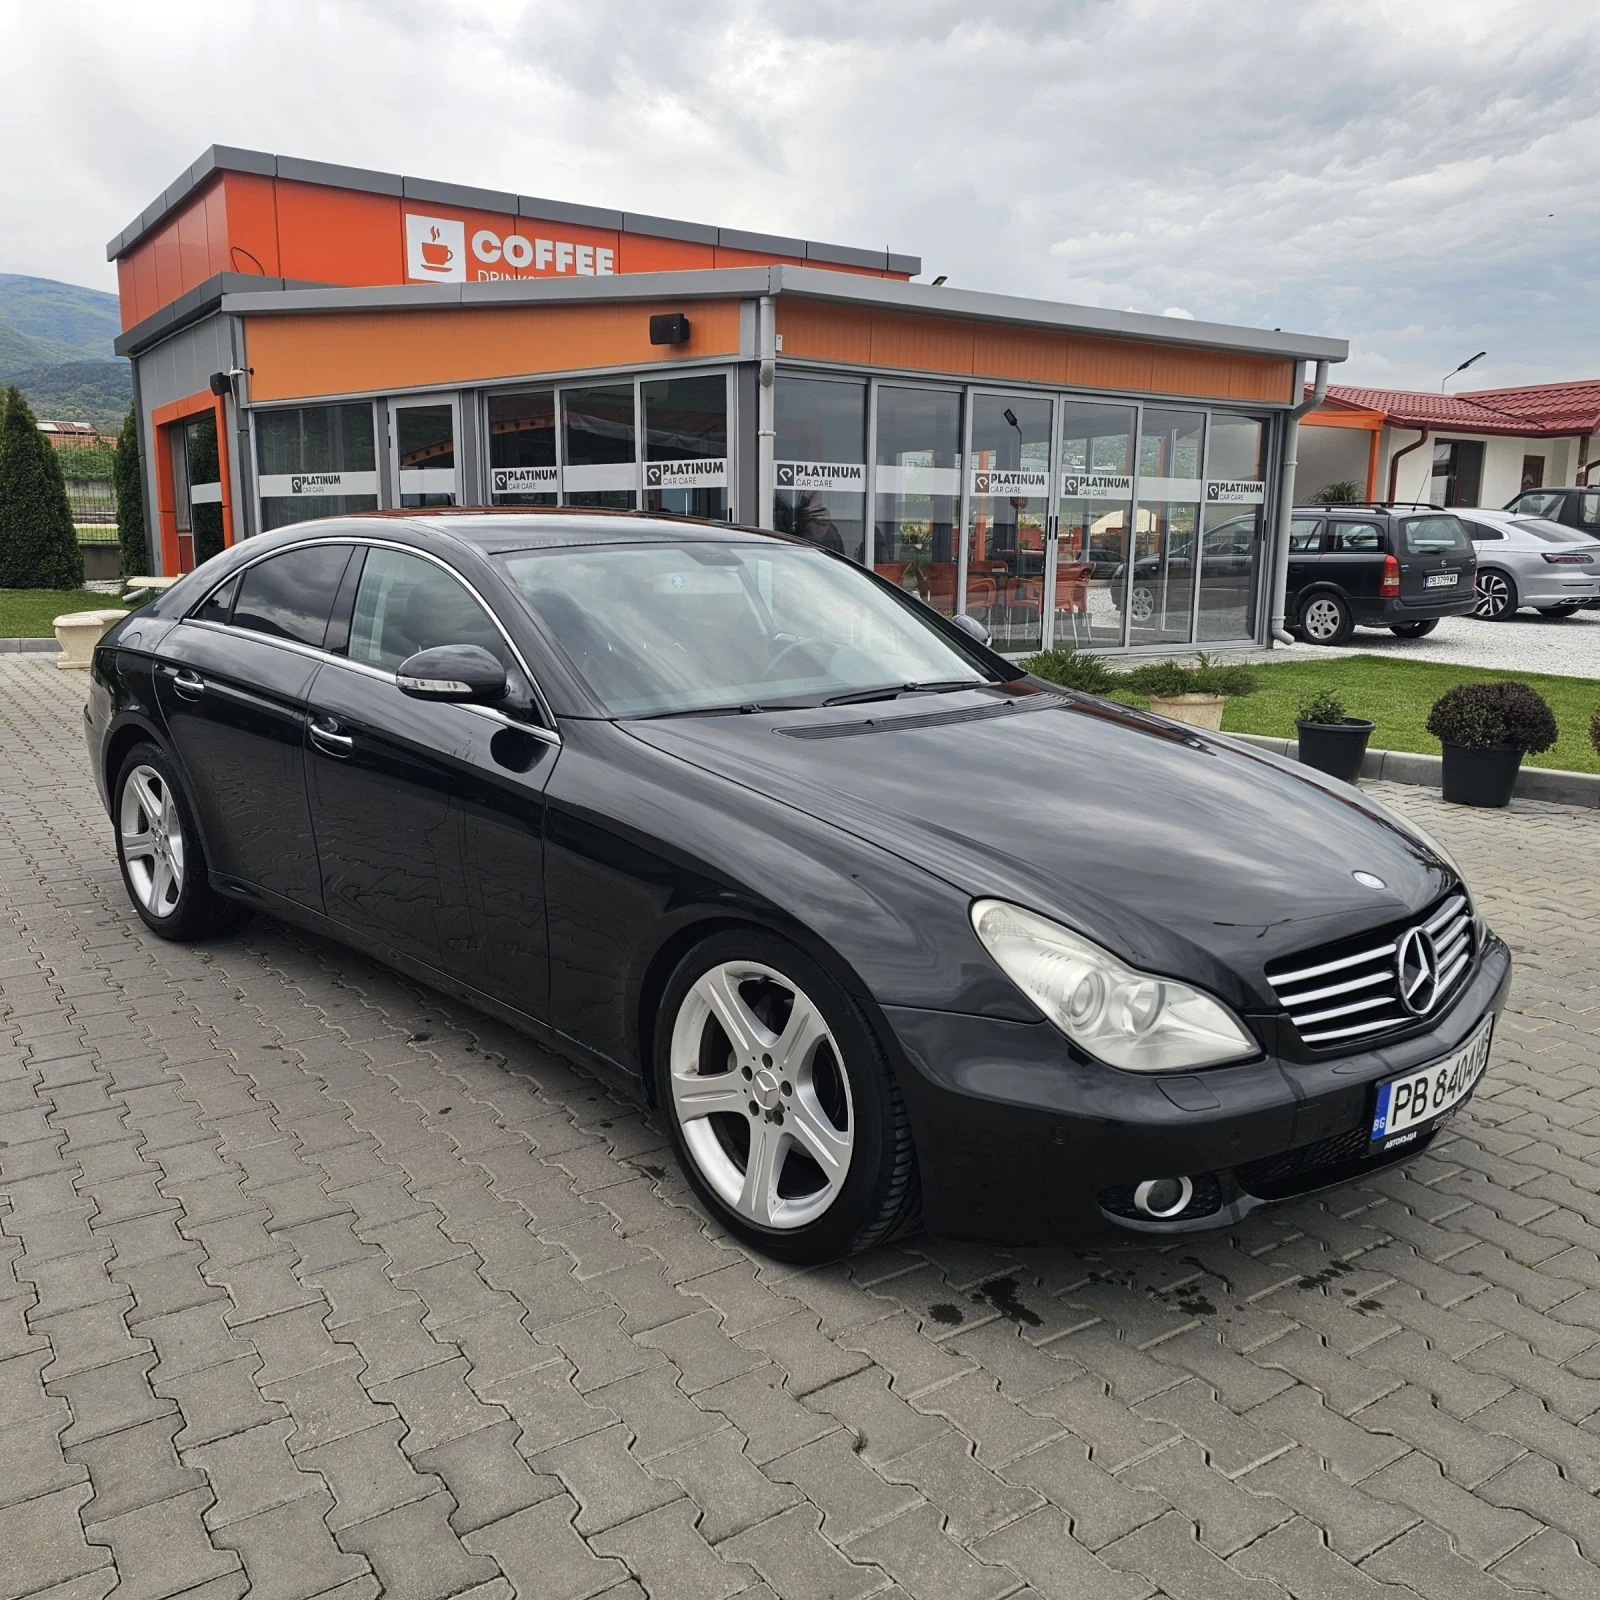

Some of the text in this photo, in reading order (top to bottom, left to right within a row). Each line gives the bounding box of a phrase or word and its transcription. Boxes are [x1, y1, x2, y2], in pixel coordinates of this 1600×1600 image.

[471, 229, 614, 276] COFFEE
[662, 462, 724, 476] PLATINUM
[795, 465, 861, 479] PLATINUM
[302, 475, 341, 486] PLATINUM
[508, 470, 557, 481] PLATINUM
[679, 477, 697, 485] CARE
[991, 473, 1045, 485] PLATINUM
[521, 482, 536, 490] CARE
[796, 479, 812, 487] CAR
[1079, 477, 1130, 489] PLATINUM
[1220, 483, 1263, 493] PLATINUM
[1391, 1077, 1429, 1127] PB
[1373, 1117, 1386, 1132] BG
